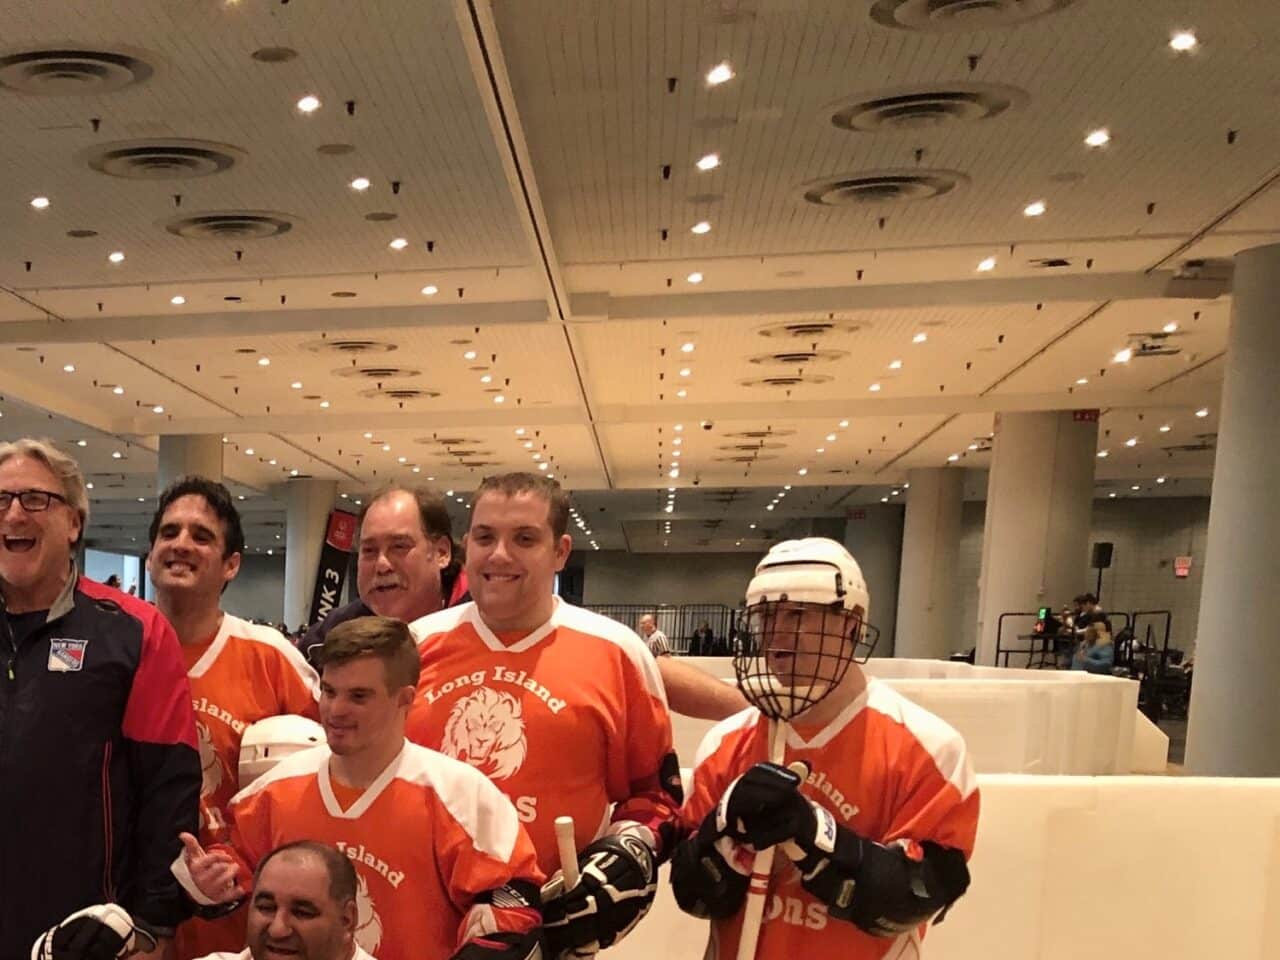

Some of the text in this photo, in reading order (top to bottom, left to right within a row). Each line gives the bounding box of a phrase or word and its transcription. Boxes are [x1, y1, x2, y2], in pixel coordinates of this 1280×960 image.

[325, 568, 340, 585] 3
[424, 666, 567, 714] Long Island
[192, 697, 245, 734] sland
[807, 770, 860, 821] sland
